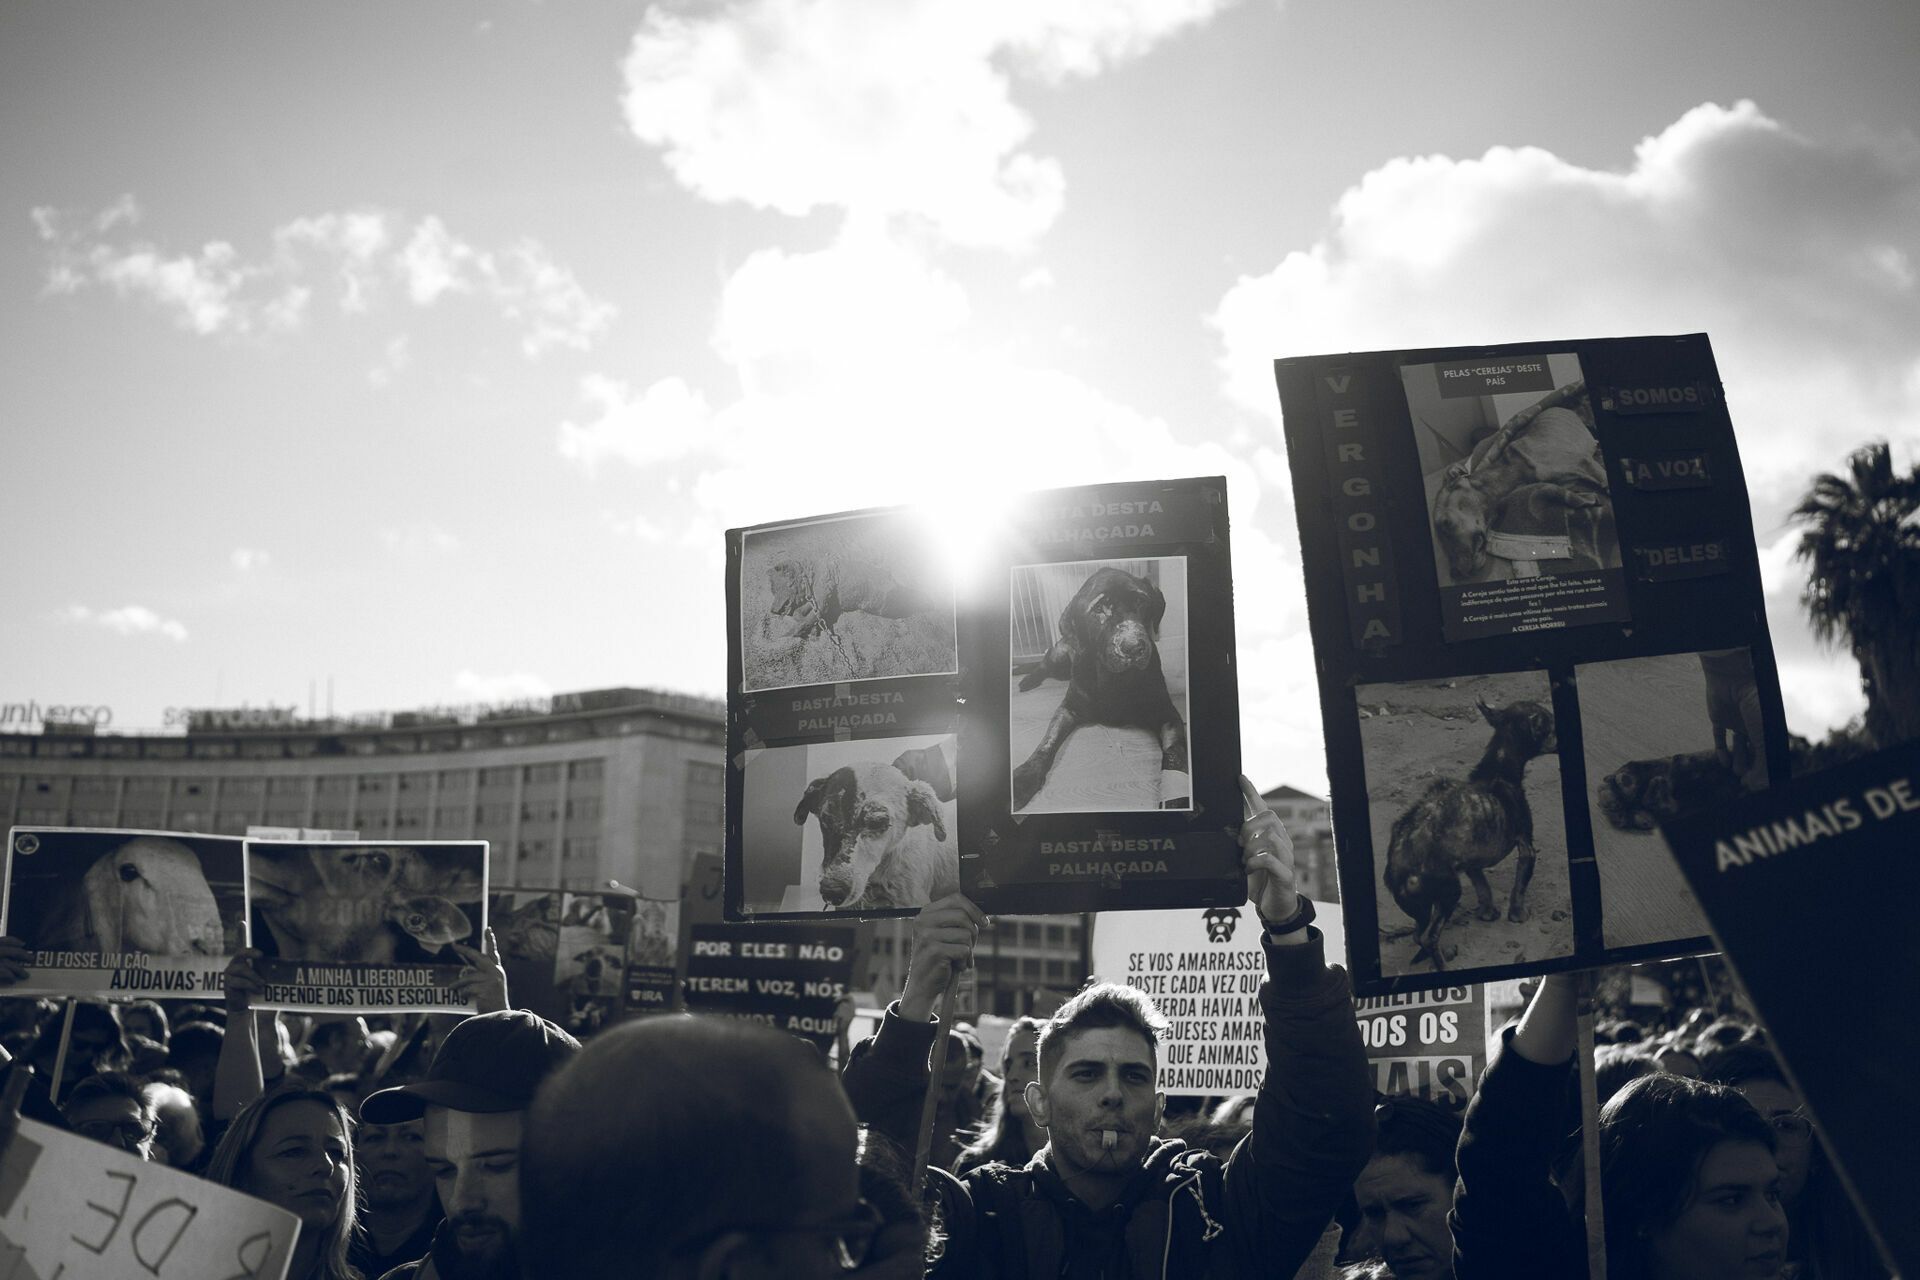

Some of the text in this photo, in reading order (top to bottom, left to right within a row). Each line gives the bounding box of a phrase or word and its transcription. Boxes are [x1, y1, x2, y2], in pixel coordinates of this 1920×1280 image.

[1443, 363, 1543, 379] PELAS "CEREJAS" DESTE
[1486, 375, 1506, 386] PAÍS
[1619, 386, 1698, 406] SOMOS
[1638, 459, 1705, 480] A VOZ
[1091, 501, 1164, 517] DESTA
[1324, 375, 1391, 640] VERGONHA
[1037, 524, 1156, 545] ALHAÇADA
[1647, 543, 1719, 567] DELES
[792, 691, 905, 712] BASTA DESTA
[798, 712, 897, 731] PALHAÇADA
[1715, 777, 1920, 873] ANIMAIS DE
[1040, 838, 1177, 854] BASTA DESTA
[35, 951, 52, 967] EU
[56, 951, 97, 968] FOSSE
[101, 952, 121, 968] UM
[124, 950, 150, 969] CÃO
[693, 940, 844, 962] POR ELES NÃO
[1128, 952, 1145, 972] SE
[1149, 952, 1173, 972] VOS
[295, 967, 434, 987] A MINHA LIBERDADE
[1170, 974, 1206, 994] CADA
[1211, 974, 1236, 993] VEZ
[1239, 974, 1263, 995] QU
[264, 985, 324, 1005] DEPENDE
[328, 987, 354, 1005] DAS
[358, 988, 394, 1006] TUAS
[688, 977, 750, 993] TEREM
[756, 979, 800, 999] VOZ,
[804, 977, 845, 1000] NÓS
[1201, 997, 1243, 1017] HAVIA
[1248, 997, 1264, 1017] M
[1165, 1021, 1217, 1041] GUESES
[1419, 1010, 1459, 1045] OS
[1168, 1044, 1259, 1065] QUE ANIMAIS
[1157, 1067, 1263, 1090] ABANDONADOS
